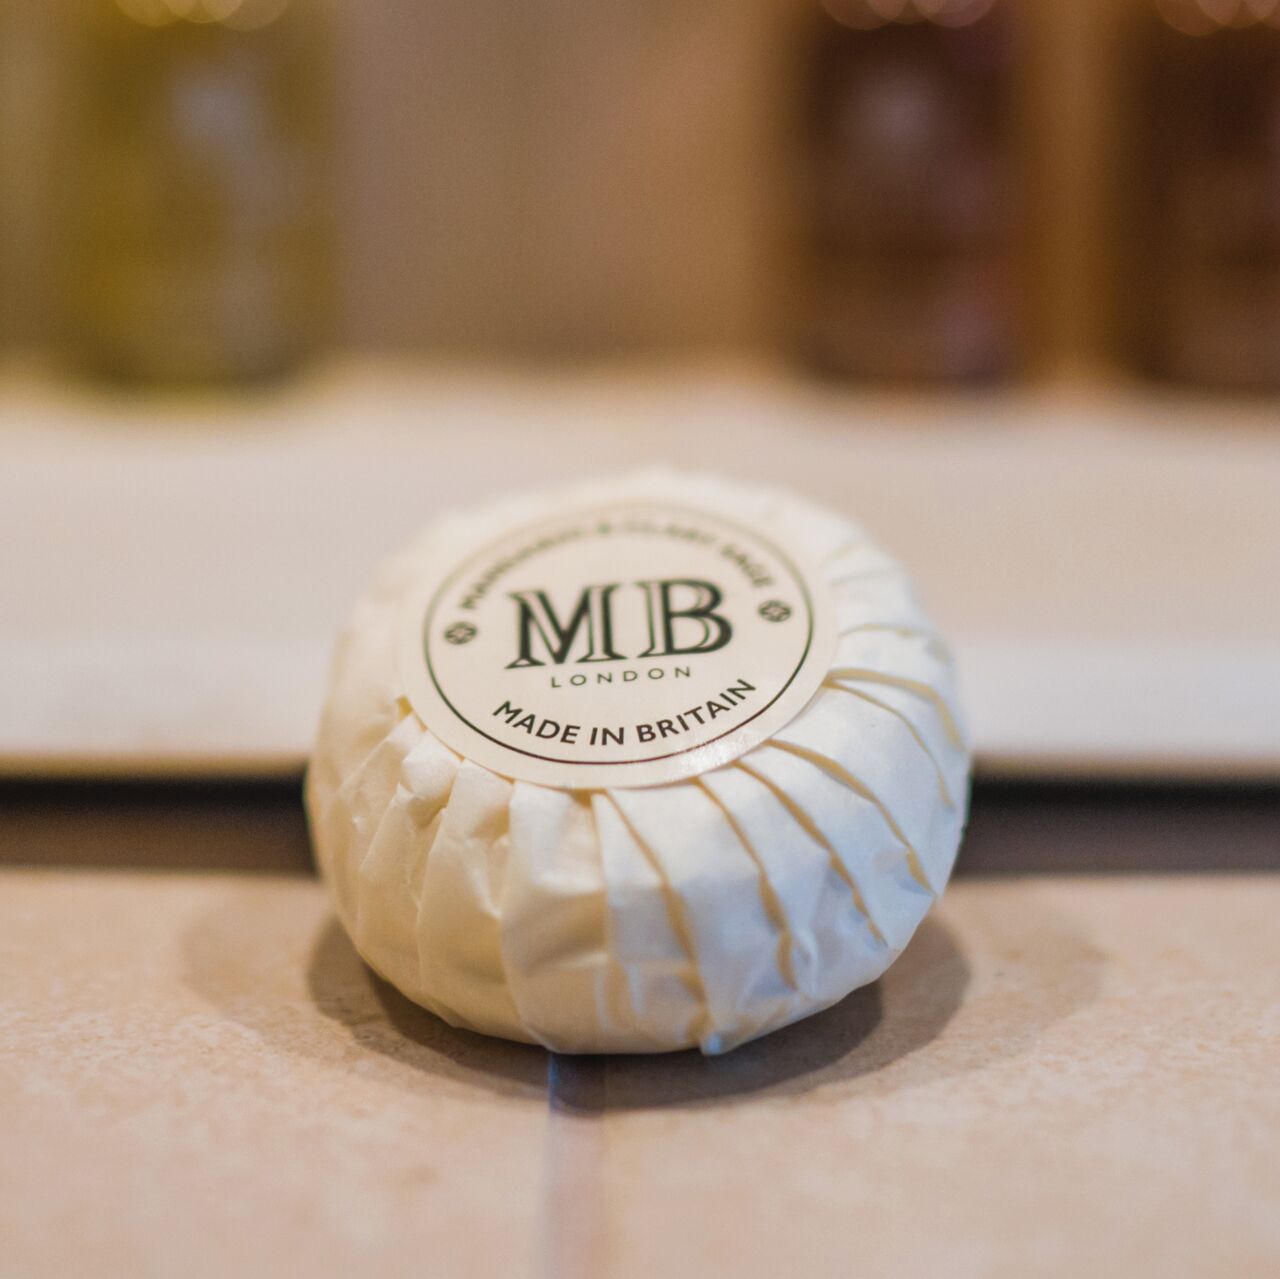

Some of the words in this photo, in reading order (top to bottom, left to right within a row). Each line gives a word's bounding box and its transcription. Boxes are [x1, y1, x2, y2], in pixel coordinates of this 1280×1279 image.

[504, 578, 733, 669] MB
[550, 666, 692, 689] LONDON
[492, 700, 581, 744] MADE
[589, 726, 625, 746] IN
[635, 678, 757, 744] BRITAIN
